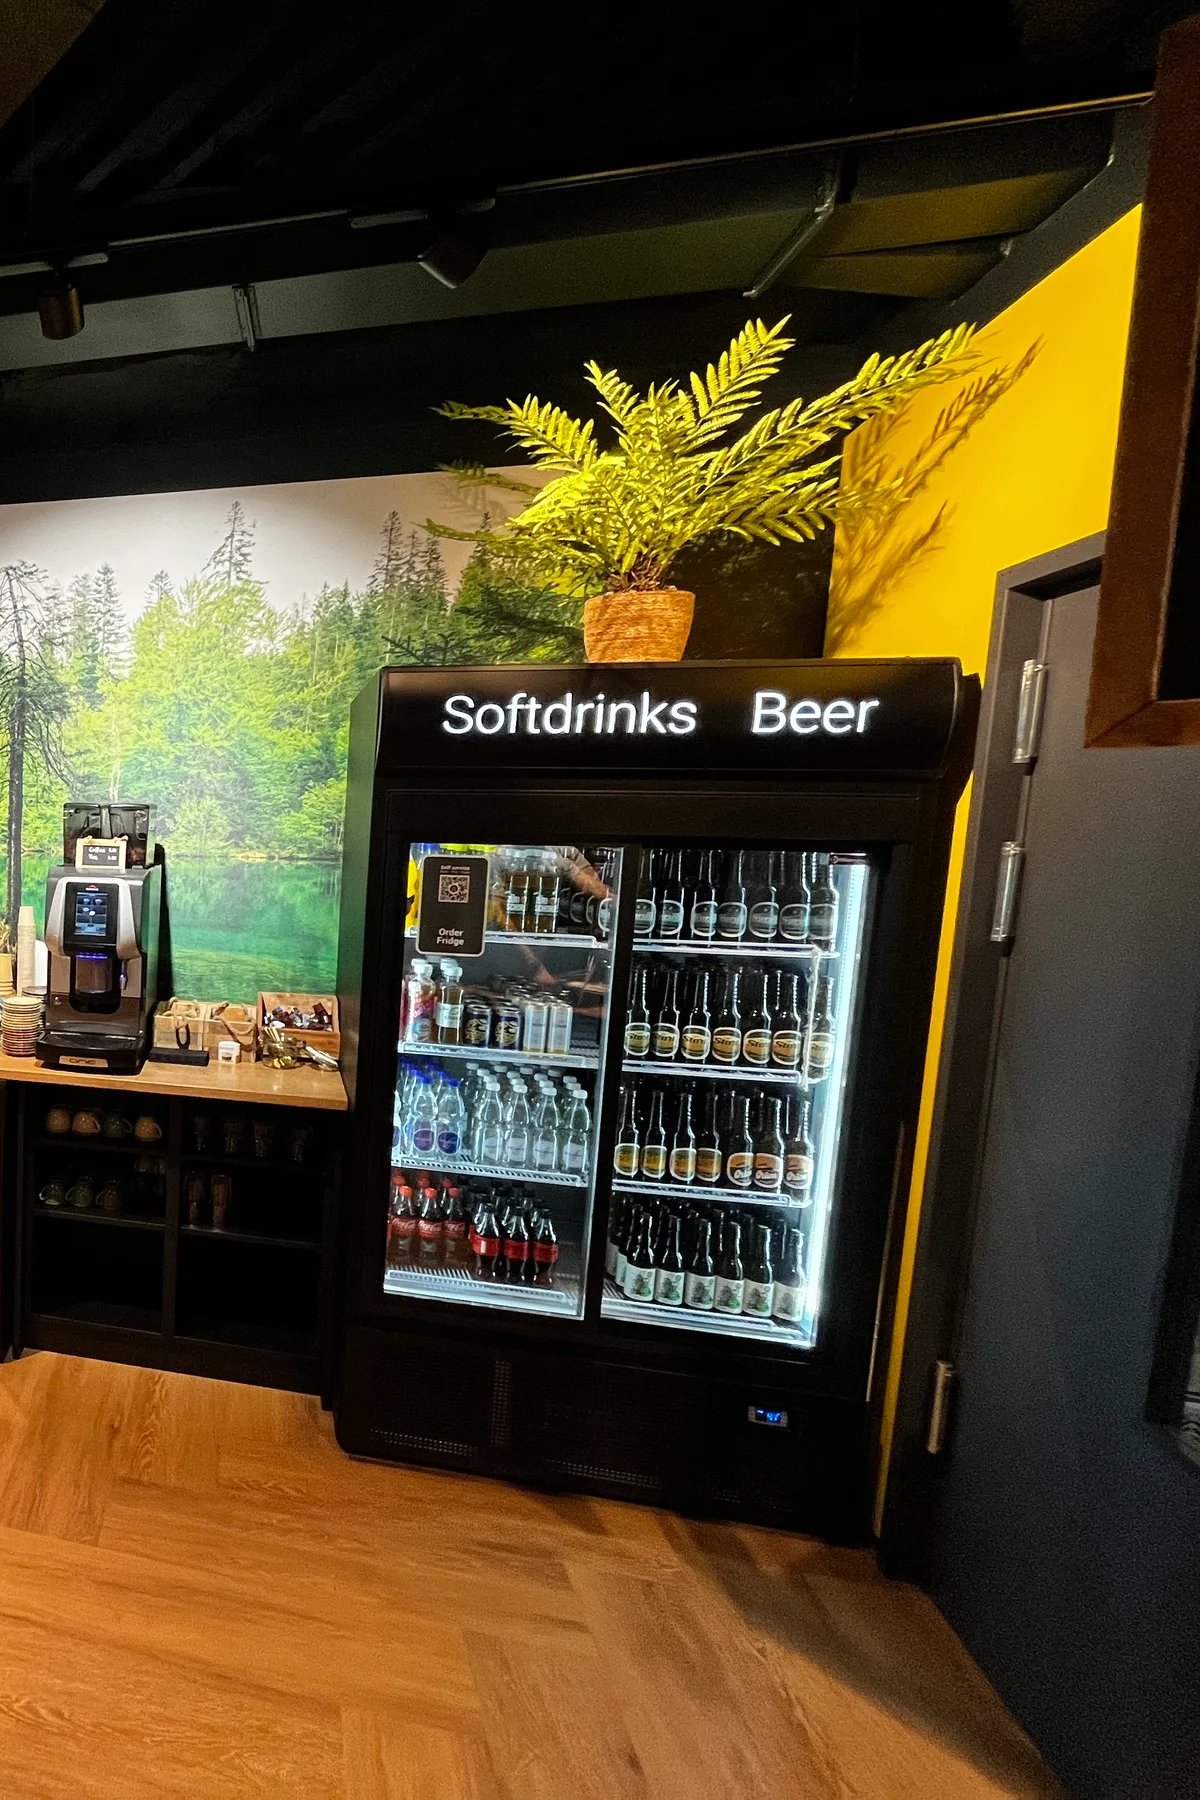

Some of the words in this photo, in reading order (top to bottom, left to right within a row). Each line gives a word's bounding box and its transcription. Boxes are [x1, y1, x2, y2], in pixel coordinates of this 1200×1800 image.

[442, 691, 698, 735] Softdrinks
[750, 690, 880, 735] Beer
[438, 928, 464, 937] Order
[436, 936, 465, 946] Fridge
